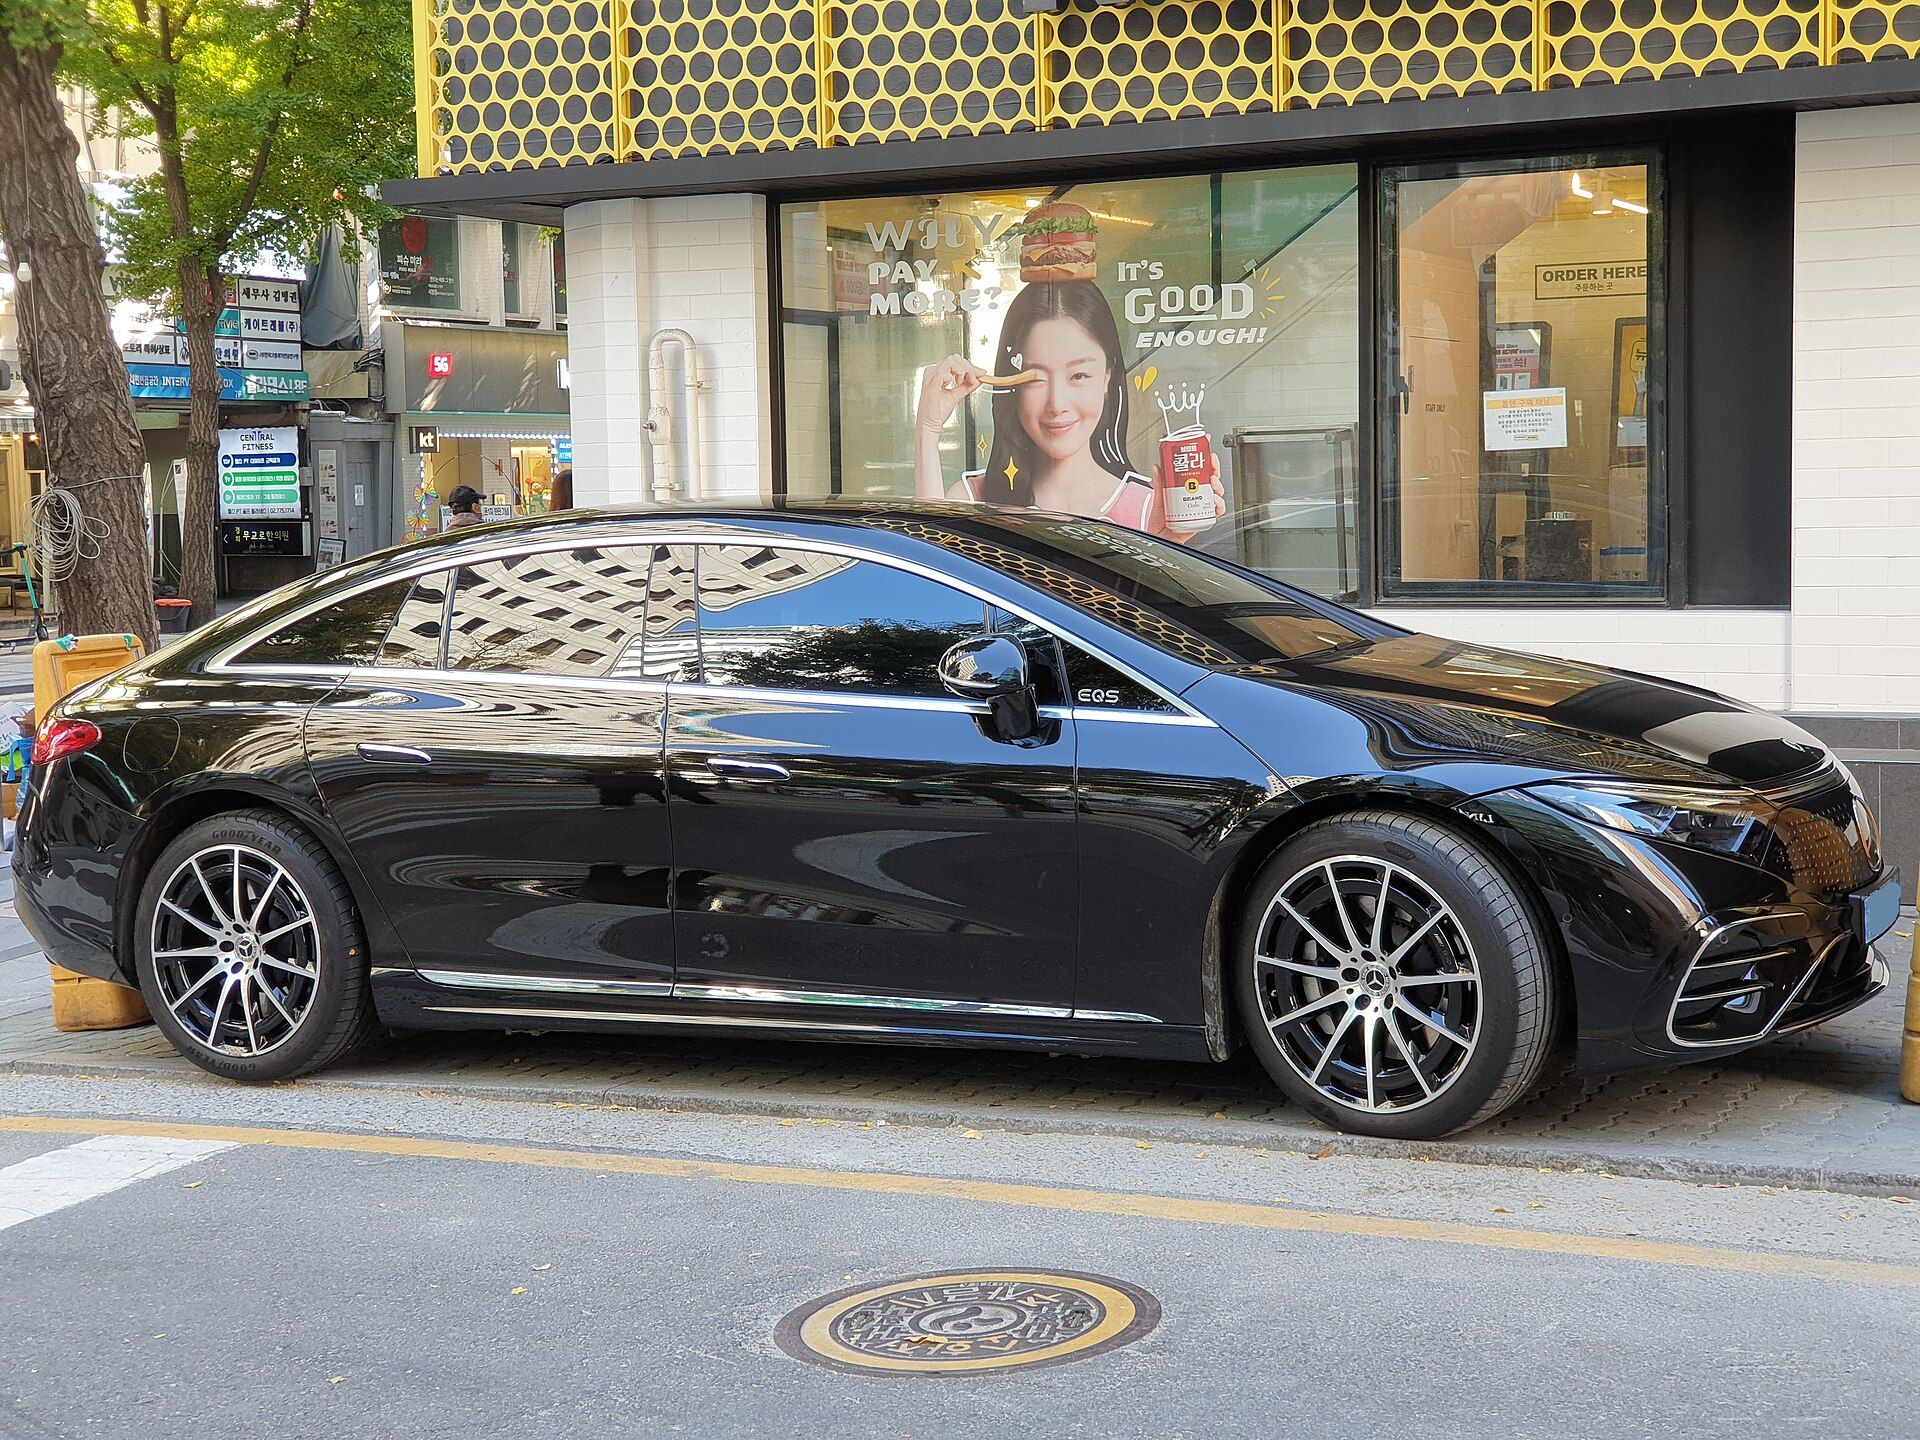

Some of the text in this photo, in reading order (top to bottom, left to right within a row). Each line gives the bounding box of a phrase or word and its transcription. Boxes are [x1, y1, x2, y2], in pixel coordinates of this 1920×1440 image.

[864, 214, 1004, 251] WHY
[867, 258, 938, 284] PAY
[1118, 260, 1164, 282] IT'S
[1542, 265, 1647, 283] ORDER HERE
[242, 287, 270, 302] 세무사
[1575, 281, 1614, 292] 주문하는 곳
[869, 286, 1002, 315] MORE?
[1125, 283, 1254, 323] GOOD
[1135, 326, 1268, 349] ENOUGH!
[162, 375, 192, 387] INTERV
[240, 431, 275, 441] CENTRAL
[419, 430, 436, 448] kt
[242, 443, 274, 451] FITNESS
[1188, 481, 1197, 490] B
[1077, 688, 1120, 703] EQS
[211, 829, 282, 854] GOODYEAR
